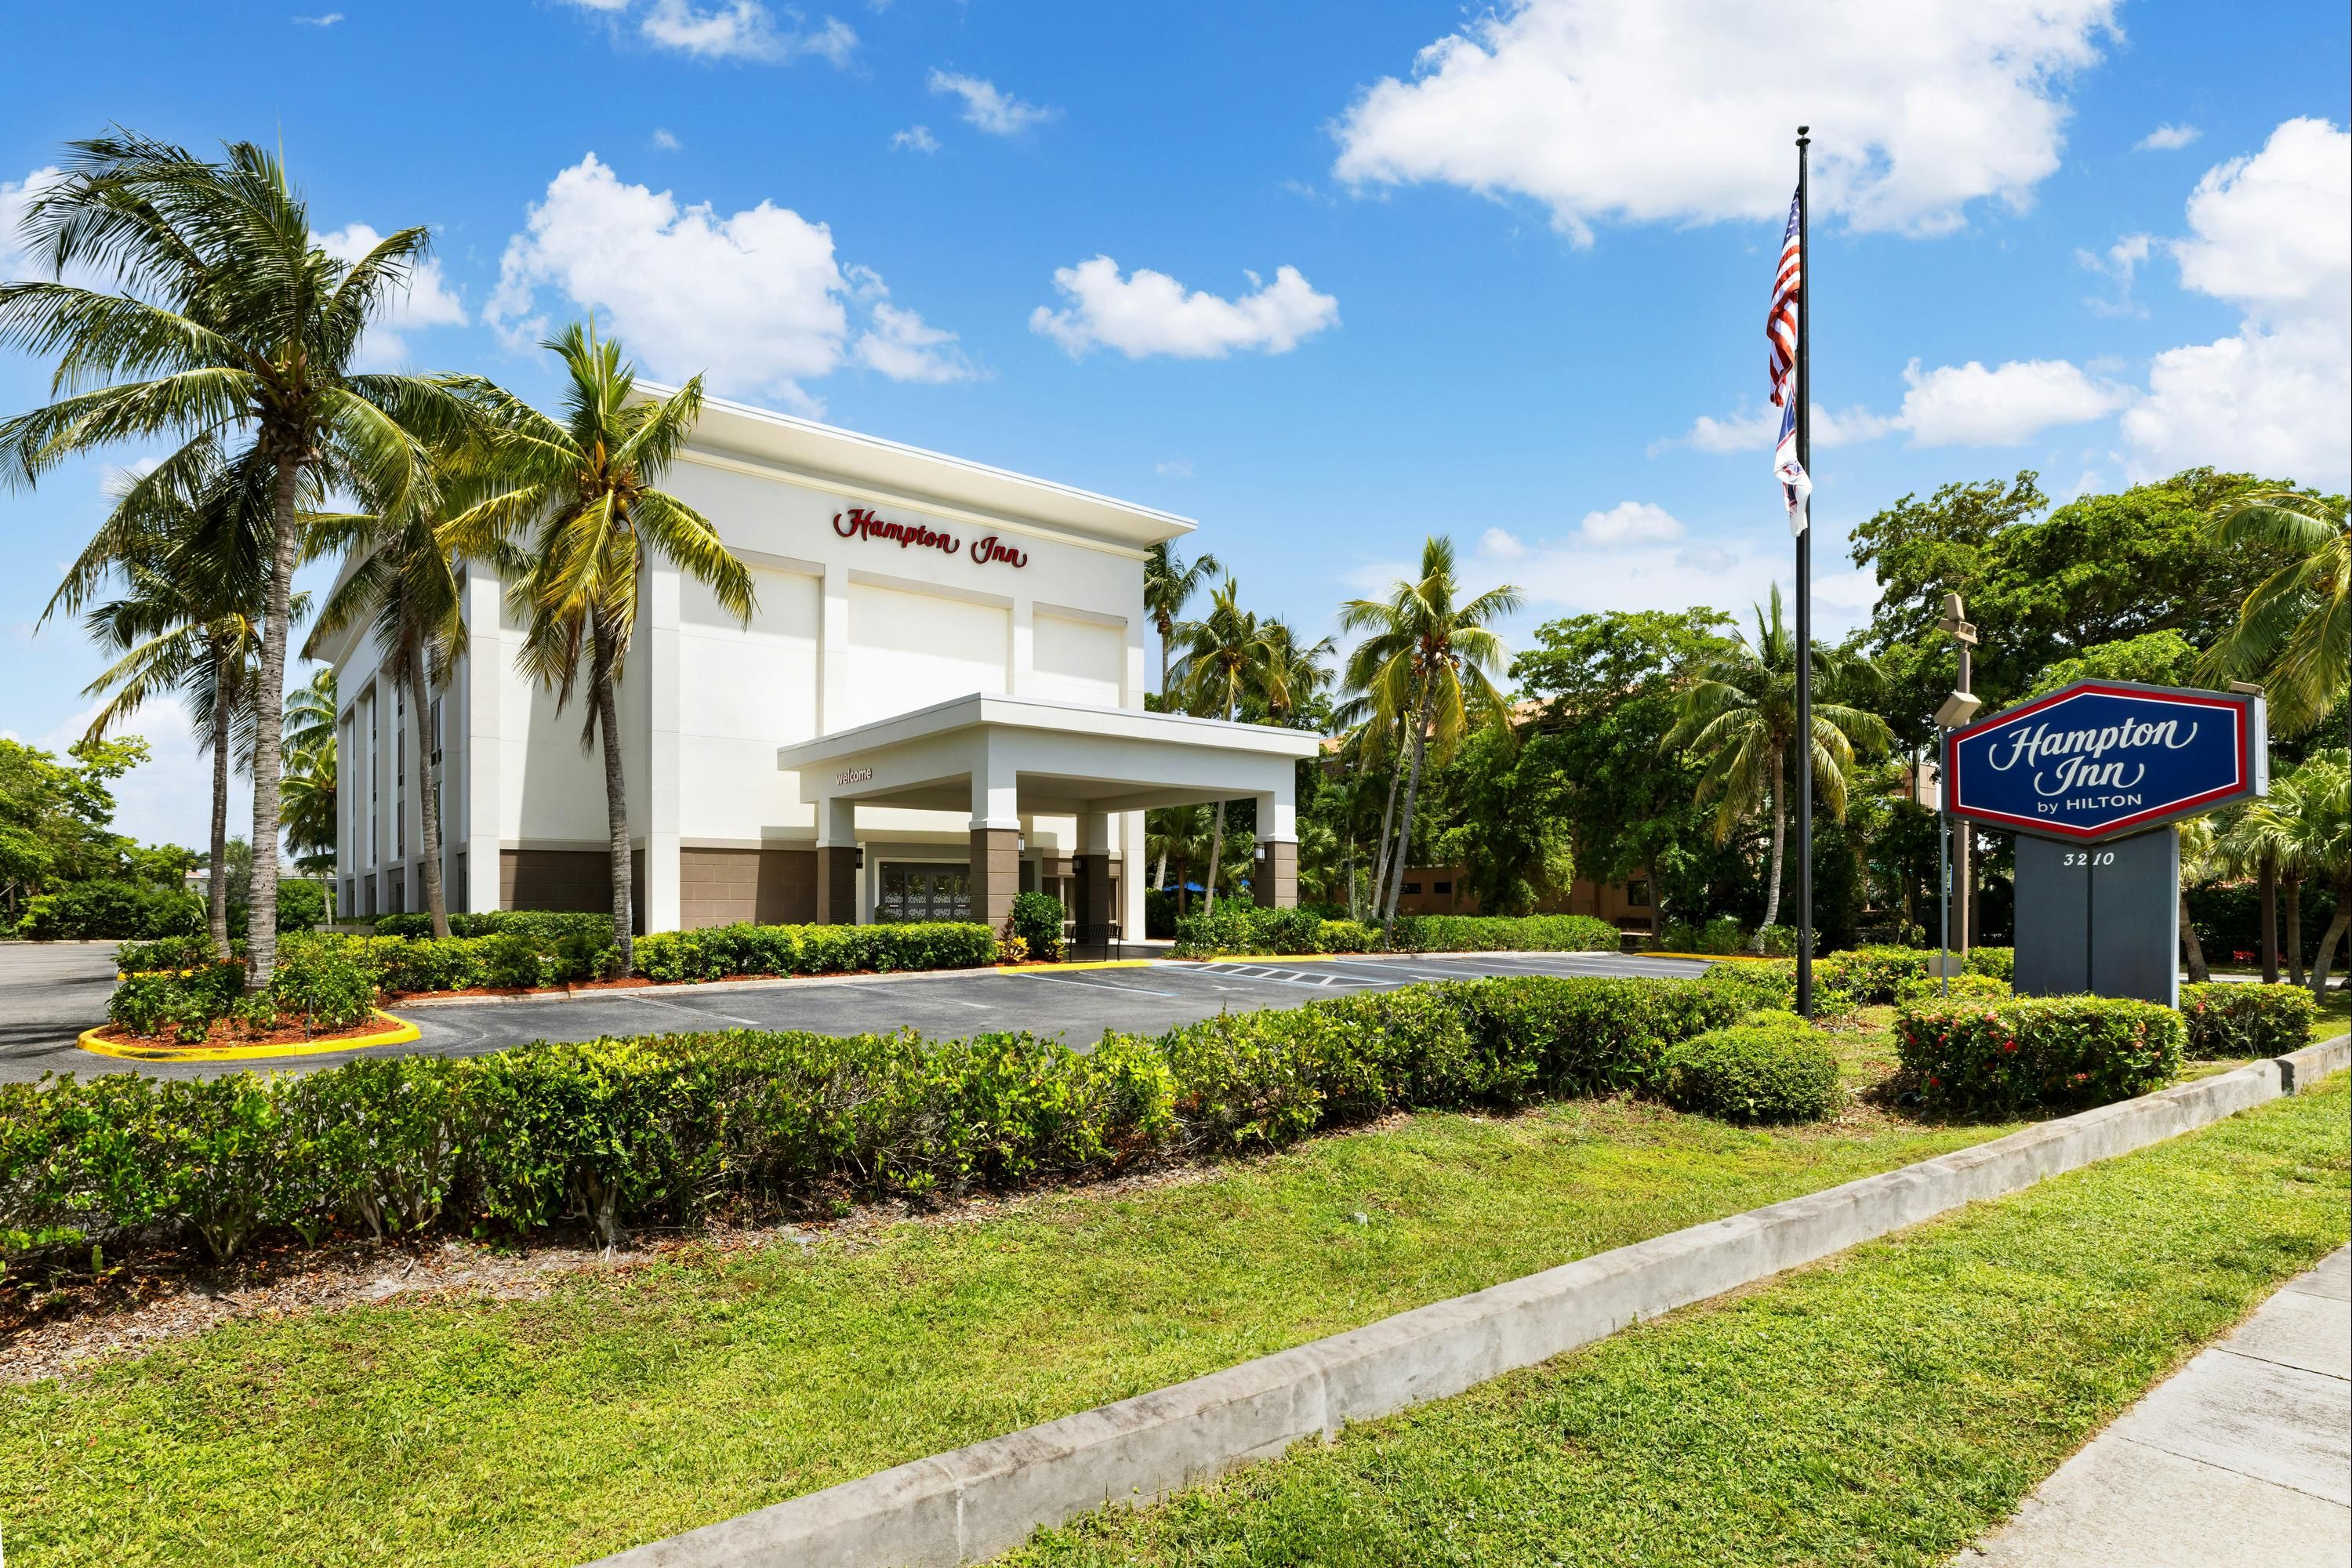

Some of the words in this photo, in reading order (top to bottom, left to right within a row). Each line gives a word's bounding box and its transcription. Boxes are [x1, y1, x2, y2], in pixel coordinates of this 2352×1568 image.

[833, 509, 960, 554] Hampton
[971, 537, 1027, 568] Inn
[1988, 717, 2198, 771] Hampton
[836, 768, 872, 785] welcome
[2034, 756, 2144, 797] Inn
[2038, 801, 2058, 815] by
[2067, 793, 2142, 811] HILTON
[2063, 852, 2114, 866] 3210
